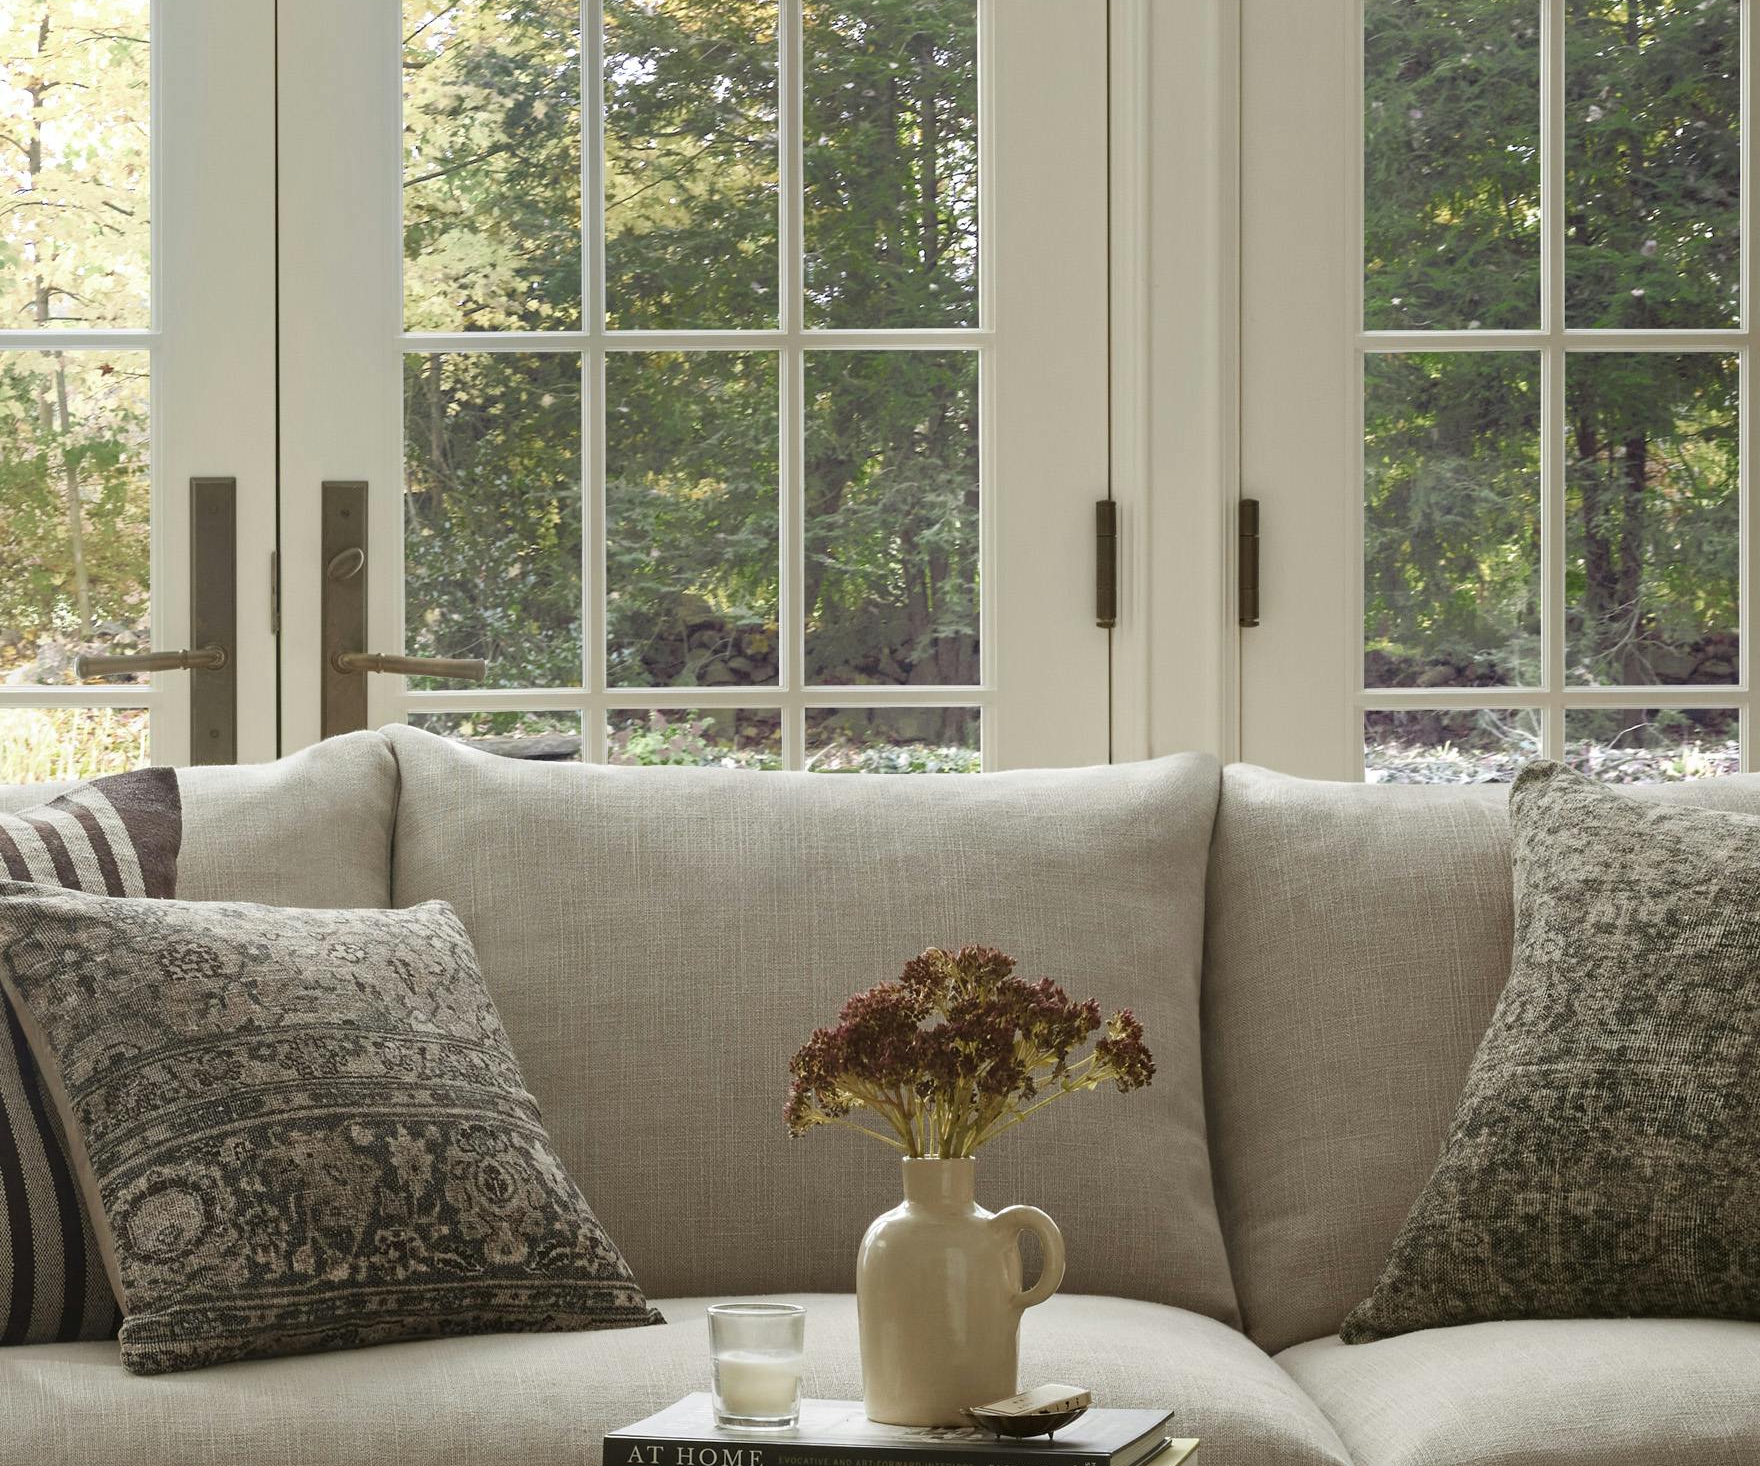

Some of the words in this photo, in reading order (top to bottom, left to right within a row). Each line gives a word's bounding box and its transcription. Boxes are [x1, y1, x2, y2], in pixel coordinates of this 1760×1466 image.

[627, 1445, 664, 1464] AT
[779, 1456, 829, 1466] EVOCATIVE
[833, 1459, 852, 1466] AND
